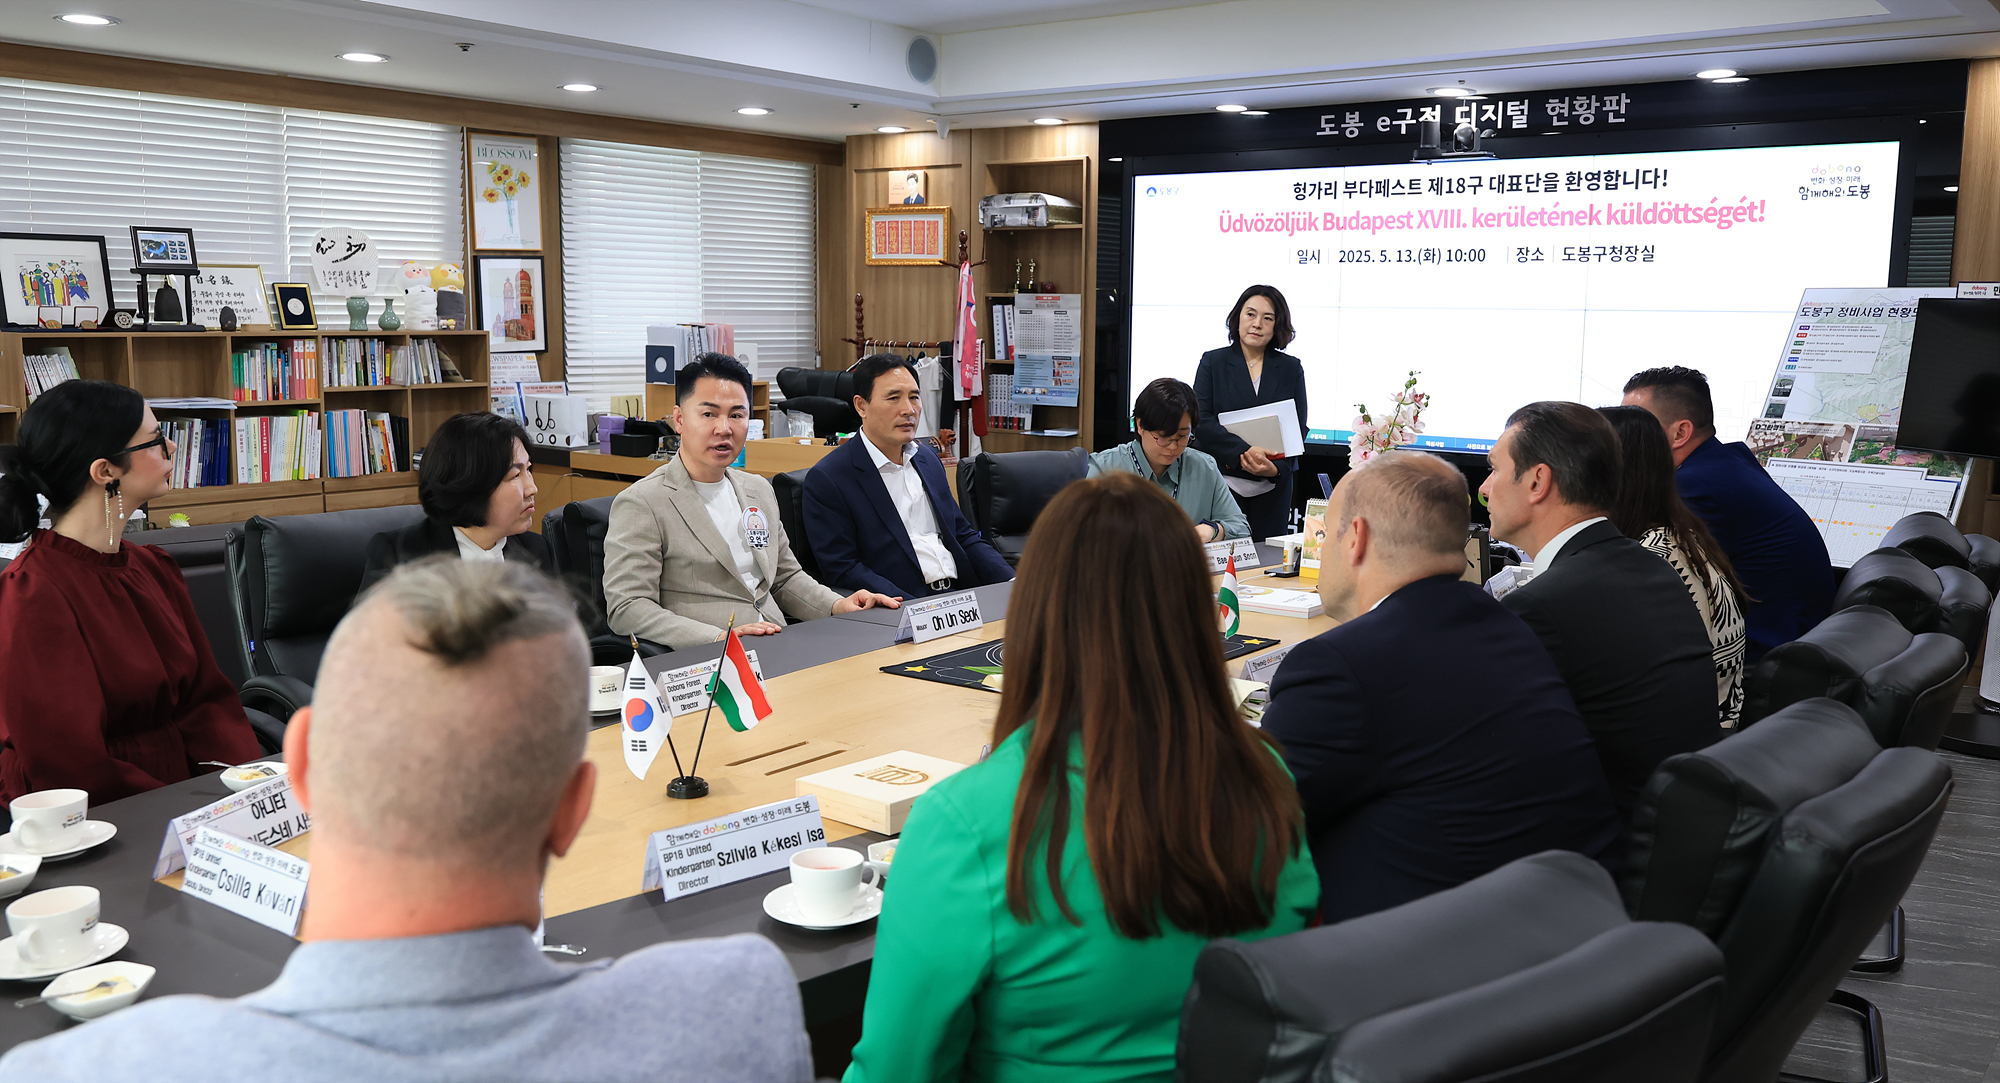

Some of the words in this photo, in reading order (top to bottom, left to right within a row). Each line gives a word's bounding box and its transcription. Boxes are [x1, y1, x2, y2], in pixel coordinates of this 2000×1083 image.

[1316, 111, 1364, 138] 도봉
[1455, 98, 1529, 129] 디지털
[1545, 92, 1631, 127] 현황판
[477, 146, 532, 160] BLOSSOM
[1293, 181, 1338, 201] 헝가리
[1343, 178, 1422, 199] 부다페스트
[1428, 175, 1484, 196] 제18구
[1489, 172, 1560, 194] 대표단을
[1565, 168, 1668, 192] 환영합니다!
[1847, 184, 1870, 199] 도봉
[1219, 209, 1319, 237] Üdvözöljük
[1322, 210, 1413, 235] Budapest
[1416, 208, 1468, 230] XVIII.
[1472, 202, 1602, 228] kerületének
[1606, 196, 1766, 230] küldöttségét!
[1297, 249, 1321, 265] 일시
[1338, 249, 1375, 264] 2025.
[1379, 249, 1392, 264] 5.
[1396, 248, 1441, 264] 13.(화)
[1446, 248, 1486, 264] 10:00
[1516, 247, 1545, 263] 장소
[1561, 245, 1656, 263] 도봉구청장실
[1800, 307, 1834, 318] 도봉구
[1838, 307, 1884, 318] 정비사업
[932, 615, 945, 631] Oh
[945, 612, 959, 628] Un
[958, 606, 980, 625] Seok
[689, 664, 712, 675] dobong
[667, 682, 686, 693] Dobong
[686, 678, 702, 689] Forest
[671, 690, 702, 703] Kindergarten
[680, 701, 699, 712] Director
[213, 798, 244, 815] dobong
[251, 791, 287, 820] 아니타
[702, 820, 740, 837] dobong
[794, 800, 812, 813] 도봉
[224, 840, 251, 858] dobong
[663, 851, 684, 864] BP18
[686, 842, 713, 858] United
[717, 845, 757, 868] Szilvia
[807, 827, 825, 844] Isa
[665, 858, 716, 879] Kindergarten
[217, 868, 252, 899] Csilla
[678, 875, 709, 892] Director
